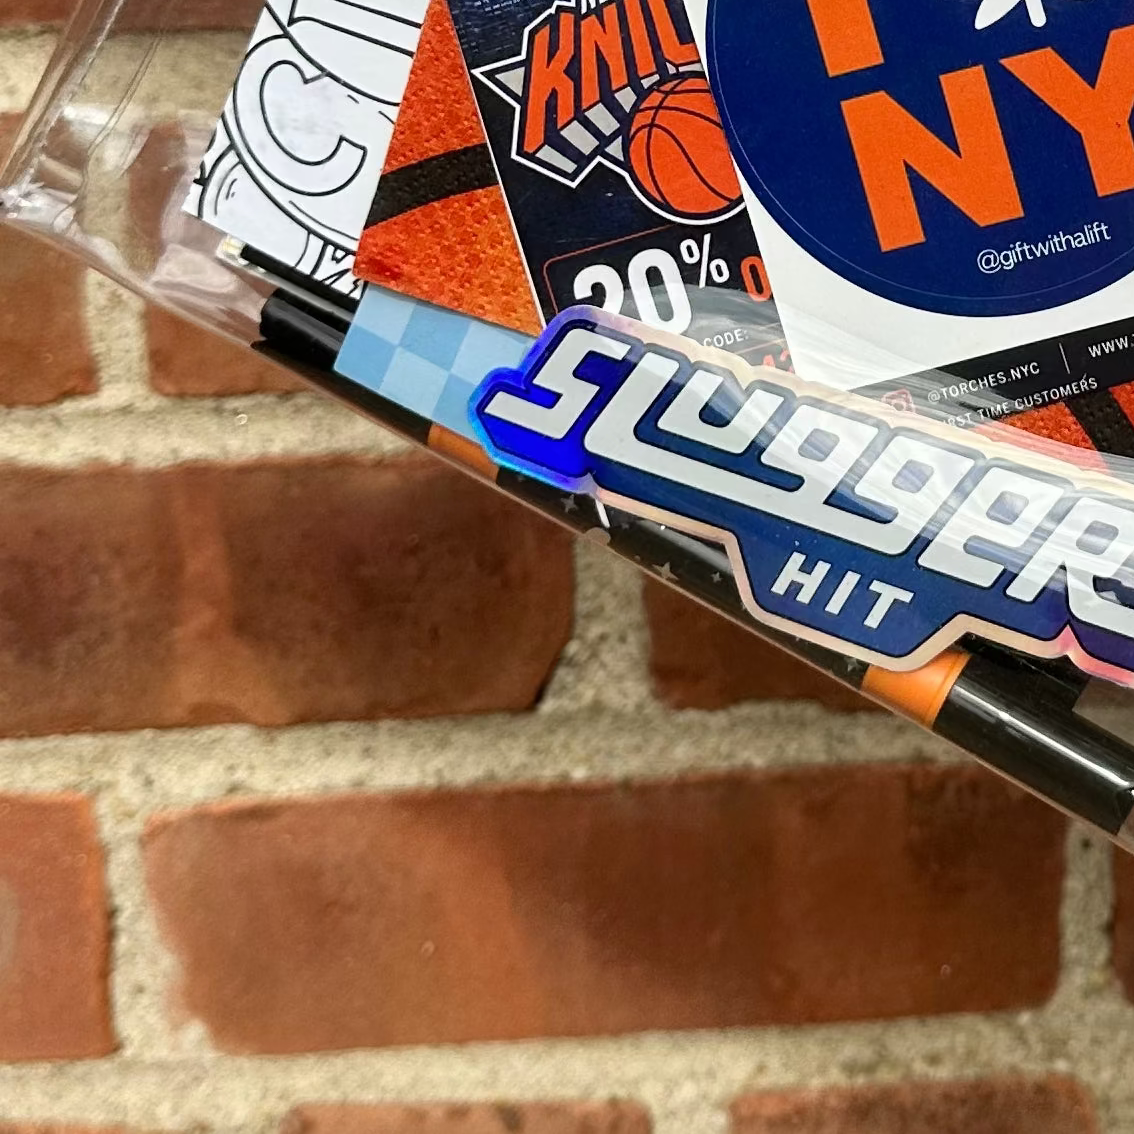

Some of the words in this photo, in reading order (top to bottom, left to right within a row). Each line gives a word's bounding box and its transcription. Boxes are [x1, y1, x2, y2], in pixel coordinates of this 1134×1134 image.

[977, 221, 1112, 274] @giftwithalift
[573, 233, 730, 336] 20%
[703, 328, 749, 348] CODE:
[927, 362, 1041, 404] @TORCHES.NYC
[977, 402, 1011, 420] TIME
[1014, 377, 1098, 411] CUSTOMERS
[770, 551, 916, 630] HIT
